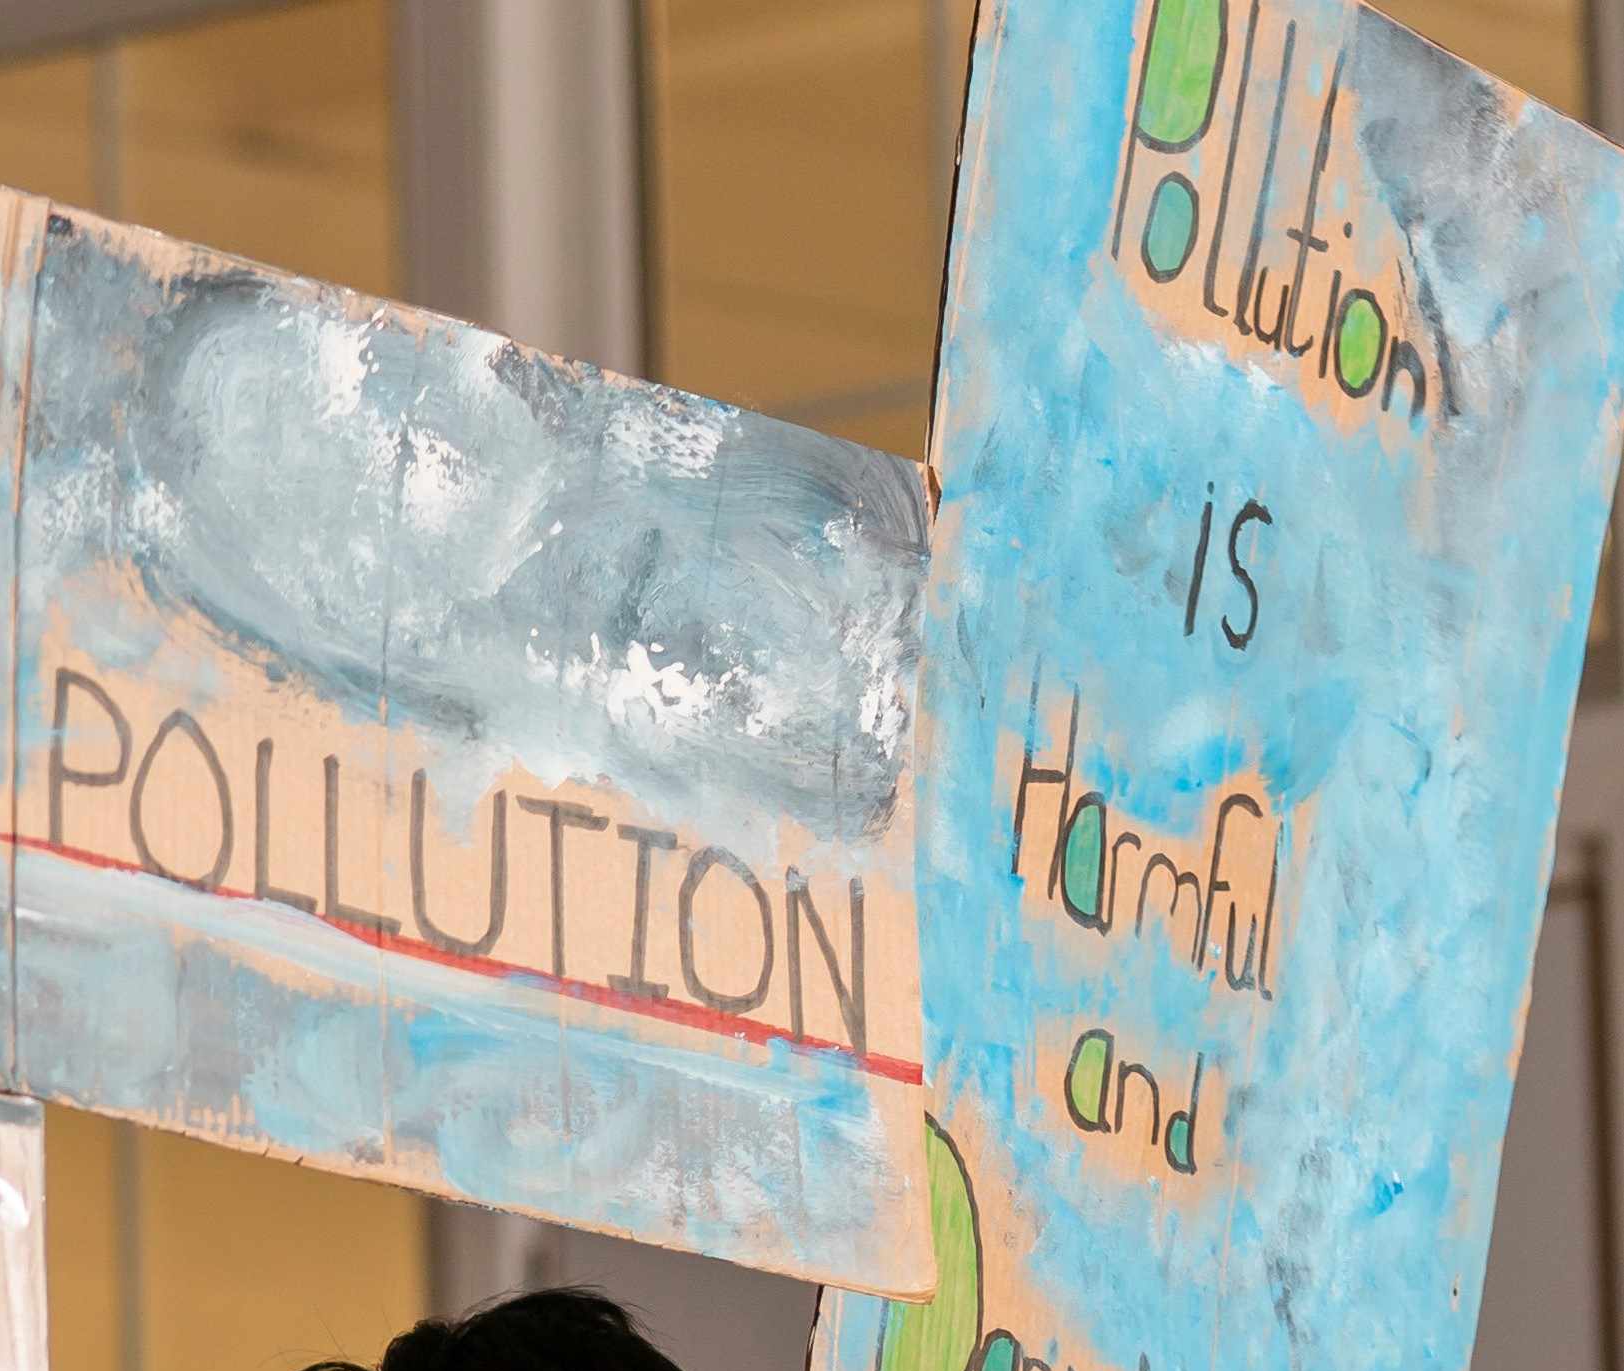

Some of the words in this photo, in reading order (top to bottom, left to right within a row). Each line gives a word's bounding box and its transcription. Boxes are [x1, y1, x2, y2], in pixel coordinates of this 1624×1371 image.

[1111, 0, 1427, 420] Pollution
[1184, 480, 1273, 650] is
[48, 667, 867, 1056] POLLUTION
[1013, 655, 1284, 1001] Harmful
[1064, 1027, 1205, 1176] and
